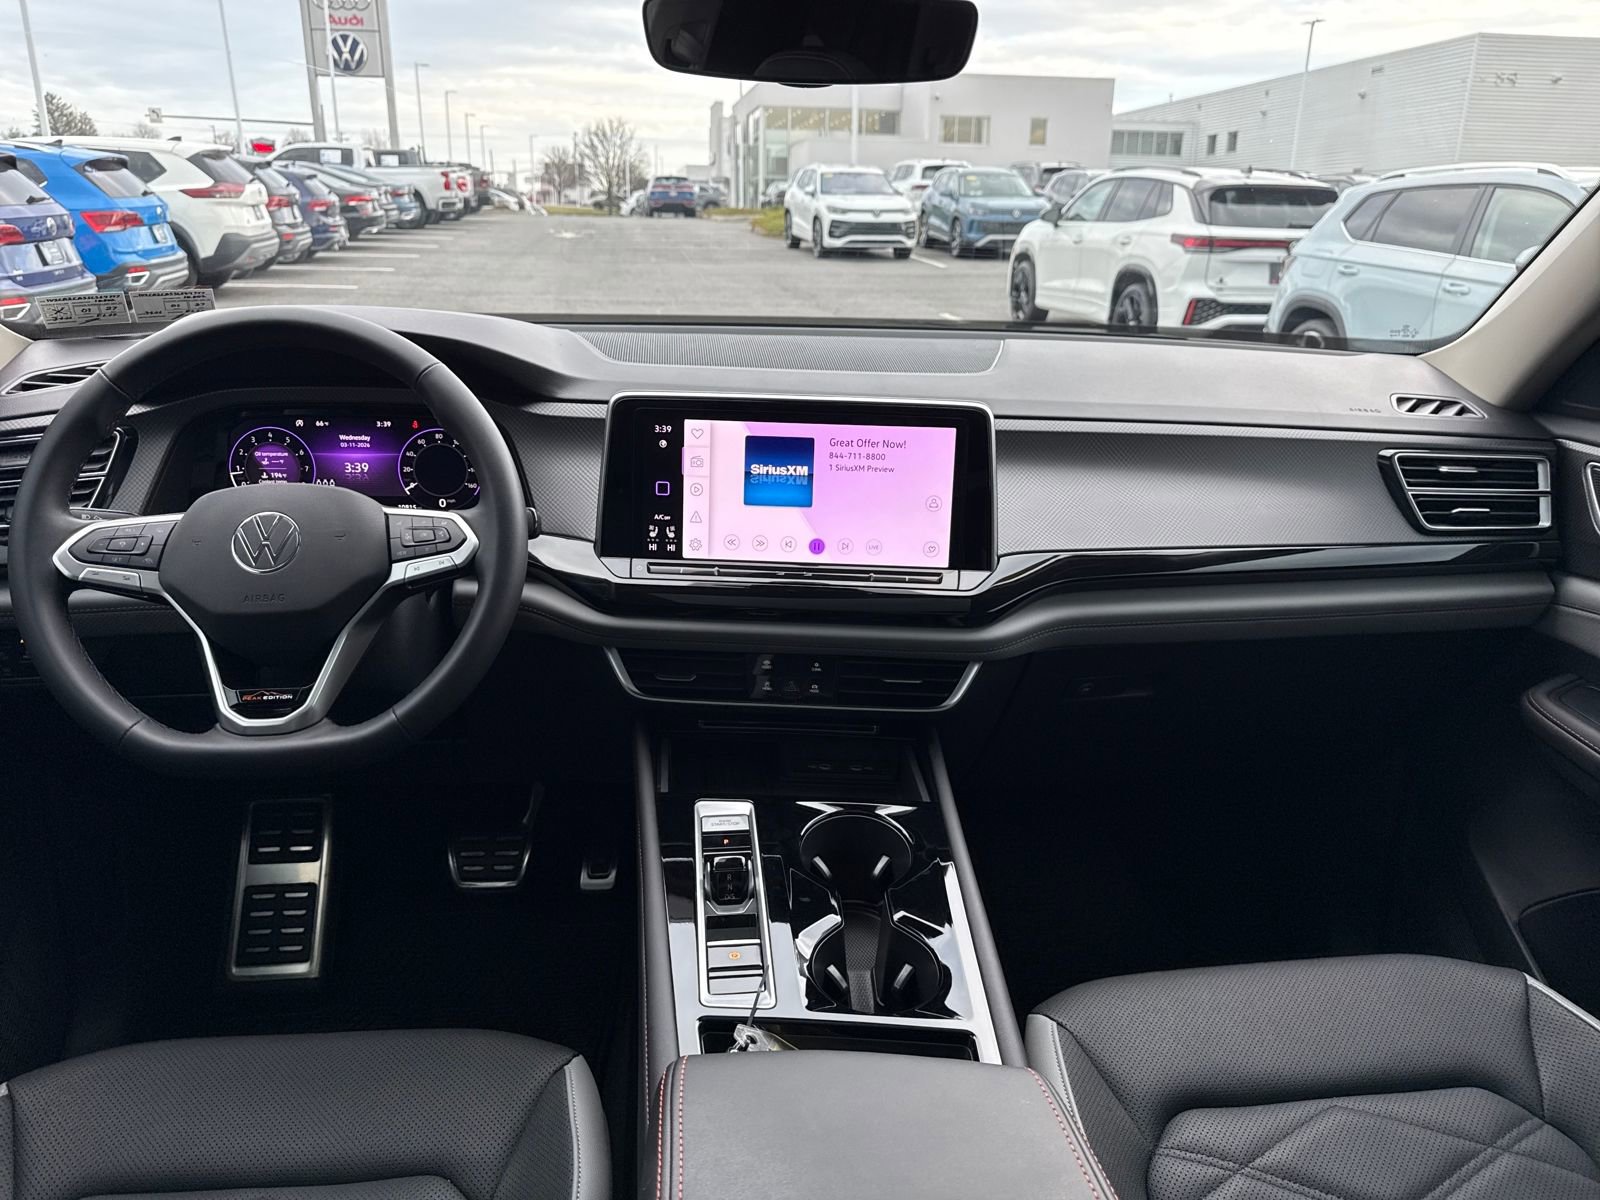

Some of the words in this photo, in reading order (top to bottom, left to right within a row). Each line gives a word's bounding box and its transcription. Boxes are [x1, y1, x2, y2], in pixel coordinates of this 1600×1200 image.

[654, 424, 672, 433] 3:39
[338, 434, 371, 442] Wednesday
[829, 437, 854, 447] Great
[856, 438, 880, 448] Offer
[882, 440, 907, 449] Now!
[828, 452, 886, 461] 844-711-8800
[344, 462, 369, 473] 3:39
[750, 464, 808, 476] SiriusXM
[835, 464, 865, 473] SiriusXM
[867, 465, 895, 473] Preview
[438, 498, 447, 508] 0
[648, 543, 657, 551] HI
[667, 544, 676, 552] HI
[243, 593, 285, 603] AIRBAG
